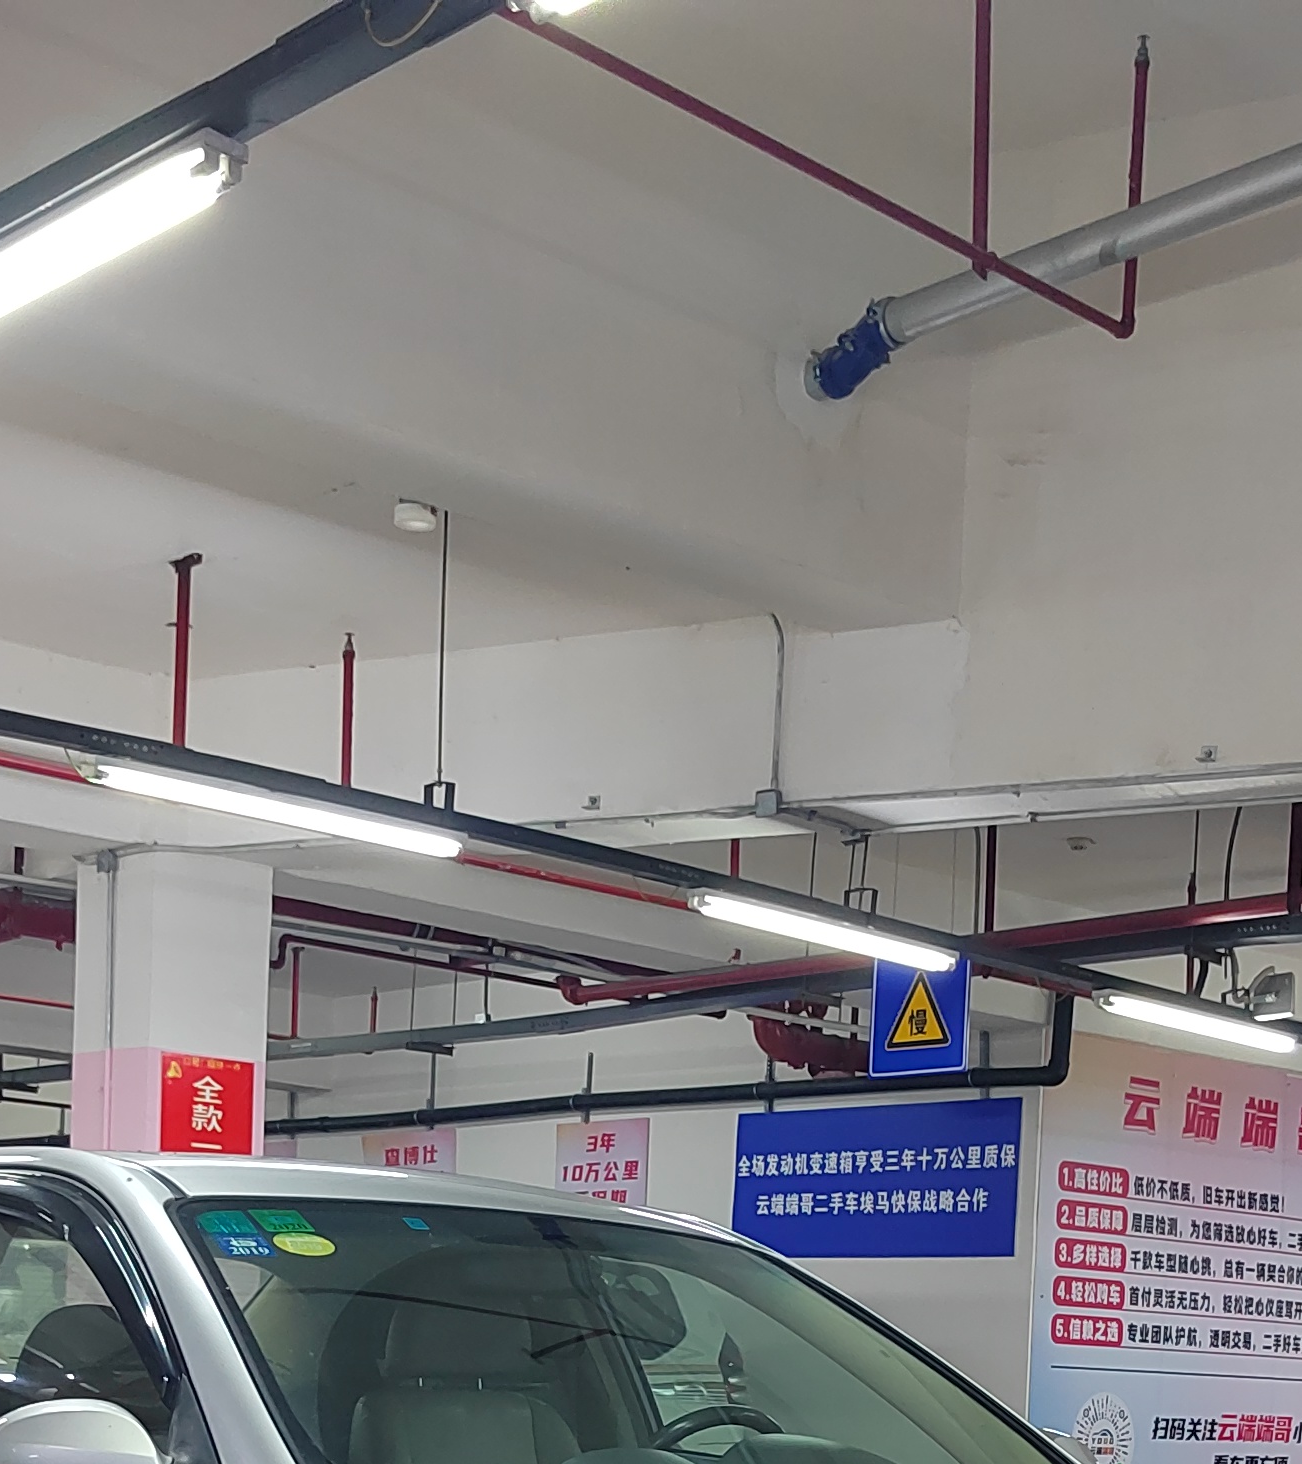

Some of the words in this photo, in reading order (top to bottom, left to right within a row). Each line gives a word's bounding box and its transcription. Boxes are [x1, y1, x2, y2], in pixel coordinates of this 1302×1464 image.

[908, 1009, 927, 1036] 慢
[191, 1075, 223, 1150] 全款一
[586, 1133, 616, 1153] 3年
[562, 1160, 640, 1183] 10万公里
[1062, 1167, 1124, 1194] 1.高性价比
[756, 1188, 989, 1216] 云端端哥二手车埃马快保战略合作
[1060, 1205, 1123, 1231] 2.品质保障
[229, 1246, 270, 1256] 2019
[1059, 1243, 1122, 1269] 3.多样选择
[1057, 1280, 1121, 1306] 4.轻松购车
[1055, 1318, 1119, 1343] 5.信赖之选
